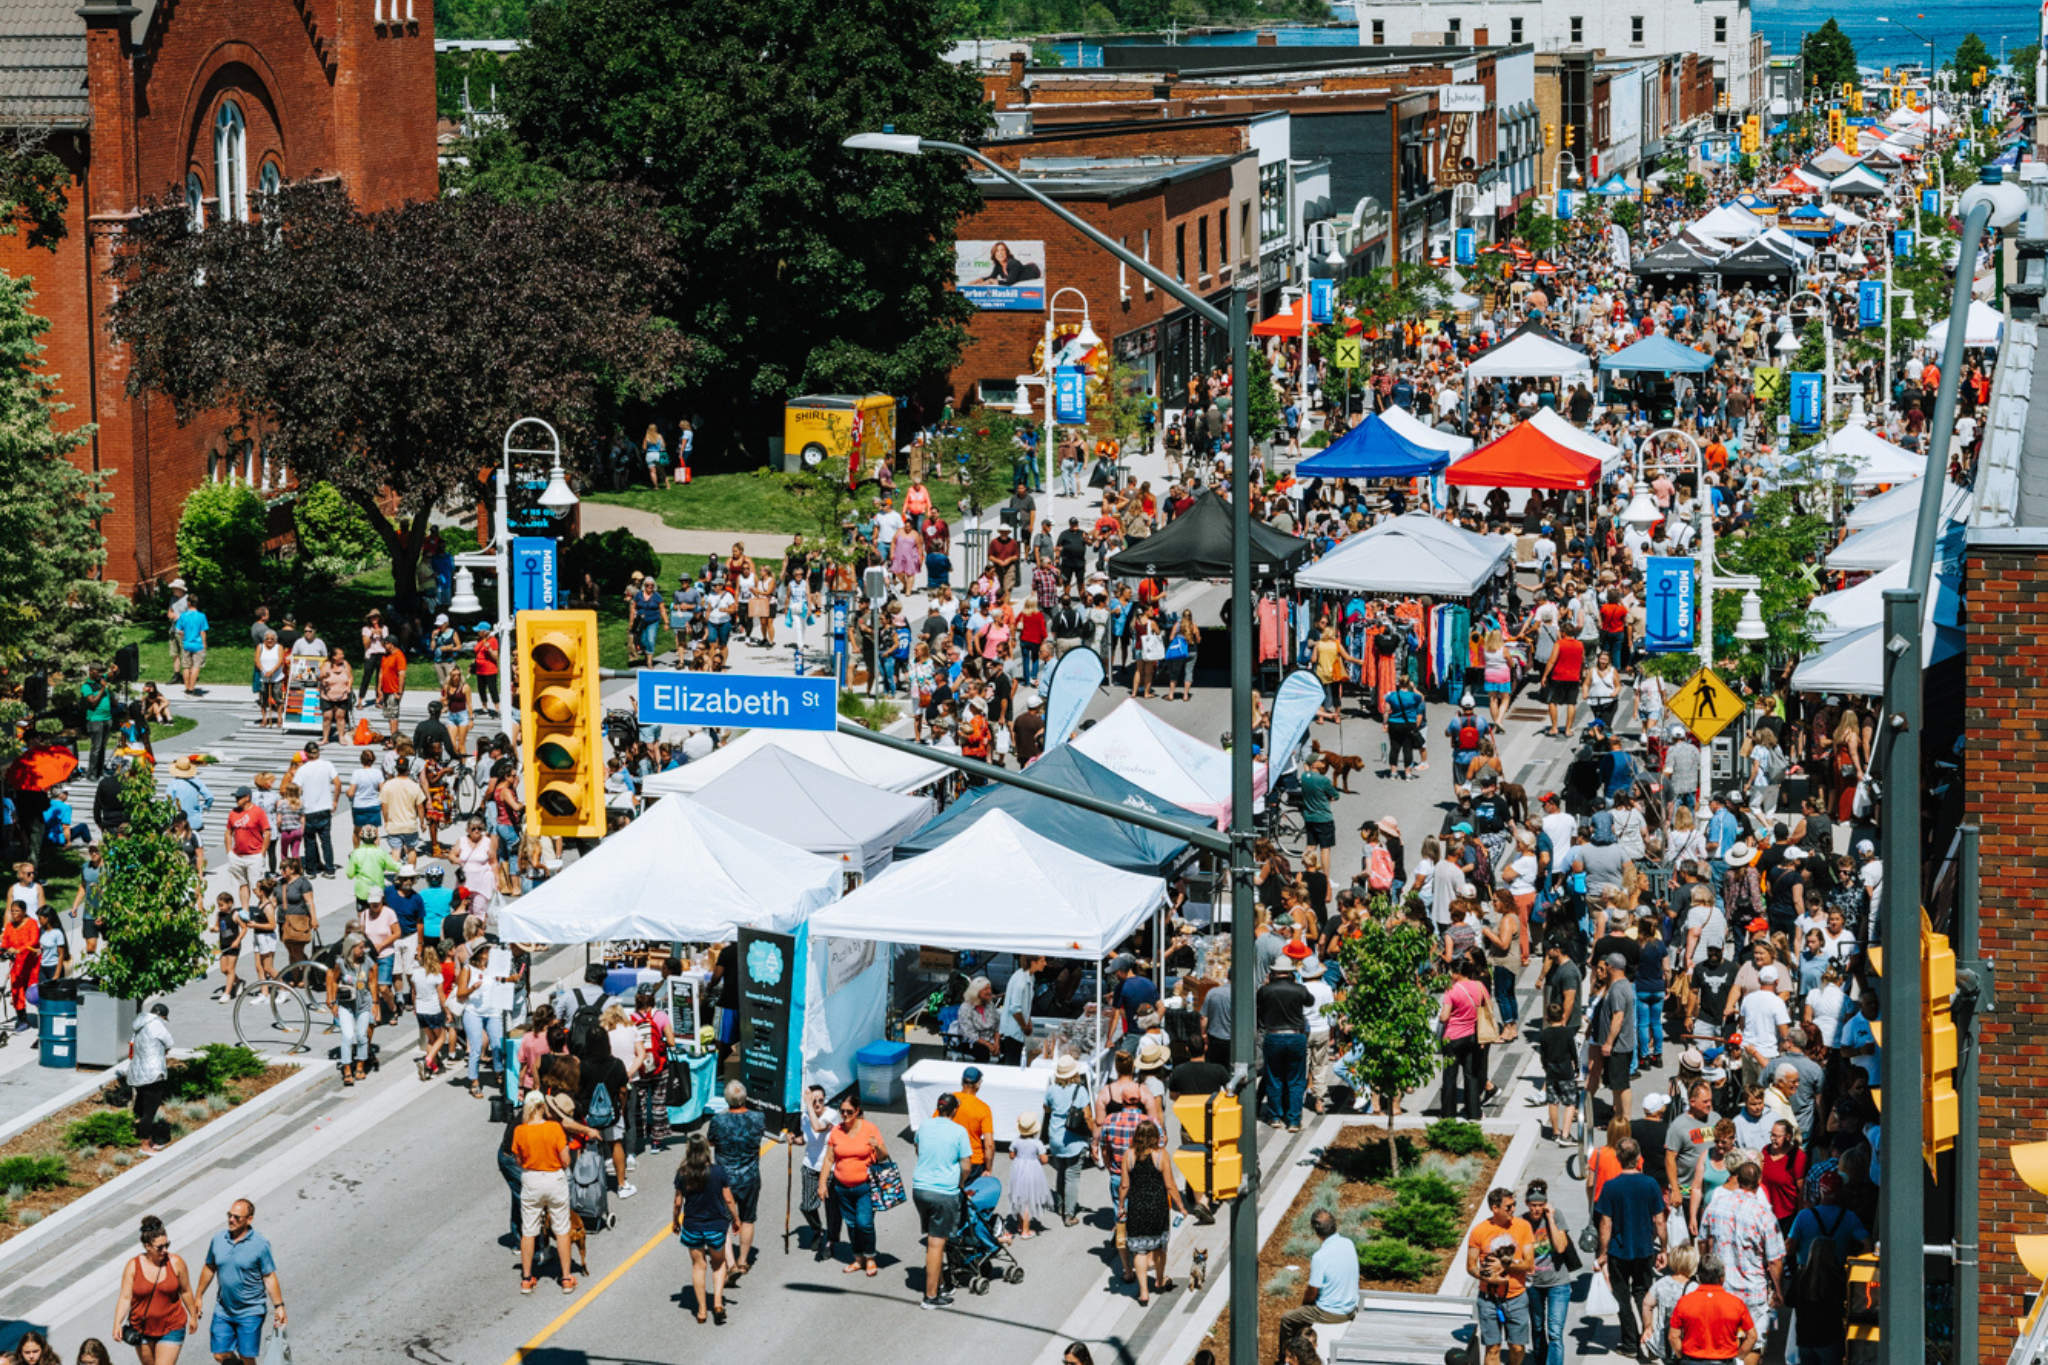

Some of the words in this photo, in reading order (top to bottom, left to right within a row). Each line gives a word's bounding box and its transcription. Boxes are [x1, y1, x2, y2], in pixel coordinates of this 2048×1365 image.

[1446, 114, 1468, 168] MUSIC
[1443, 173, 1474, 181] LAND
[795, 410, 842, 425] SHIRLEY
[542, 550, 553, 604] MIDLAND
[1678, 570, 1689, 628] MIDLAND
[653, 684, 790, 716] Elizabeth
[801, 690, 820, 708] St
